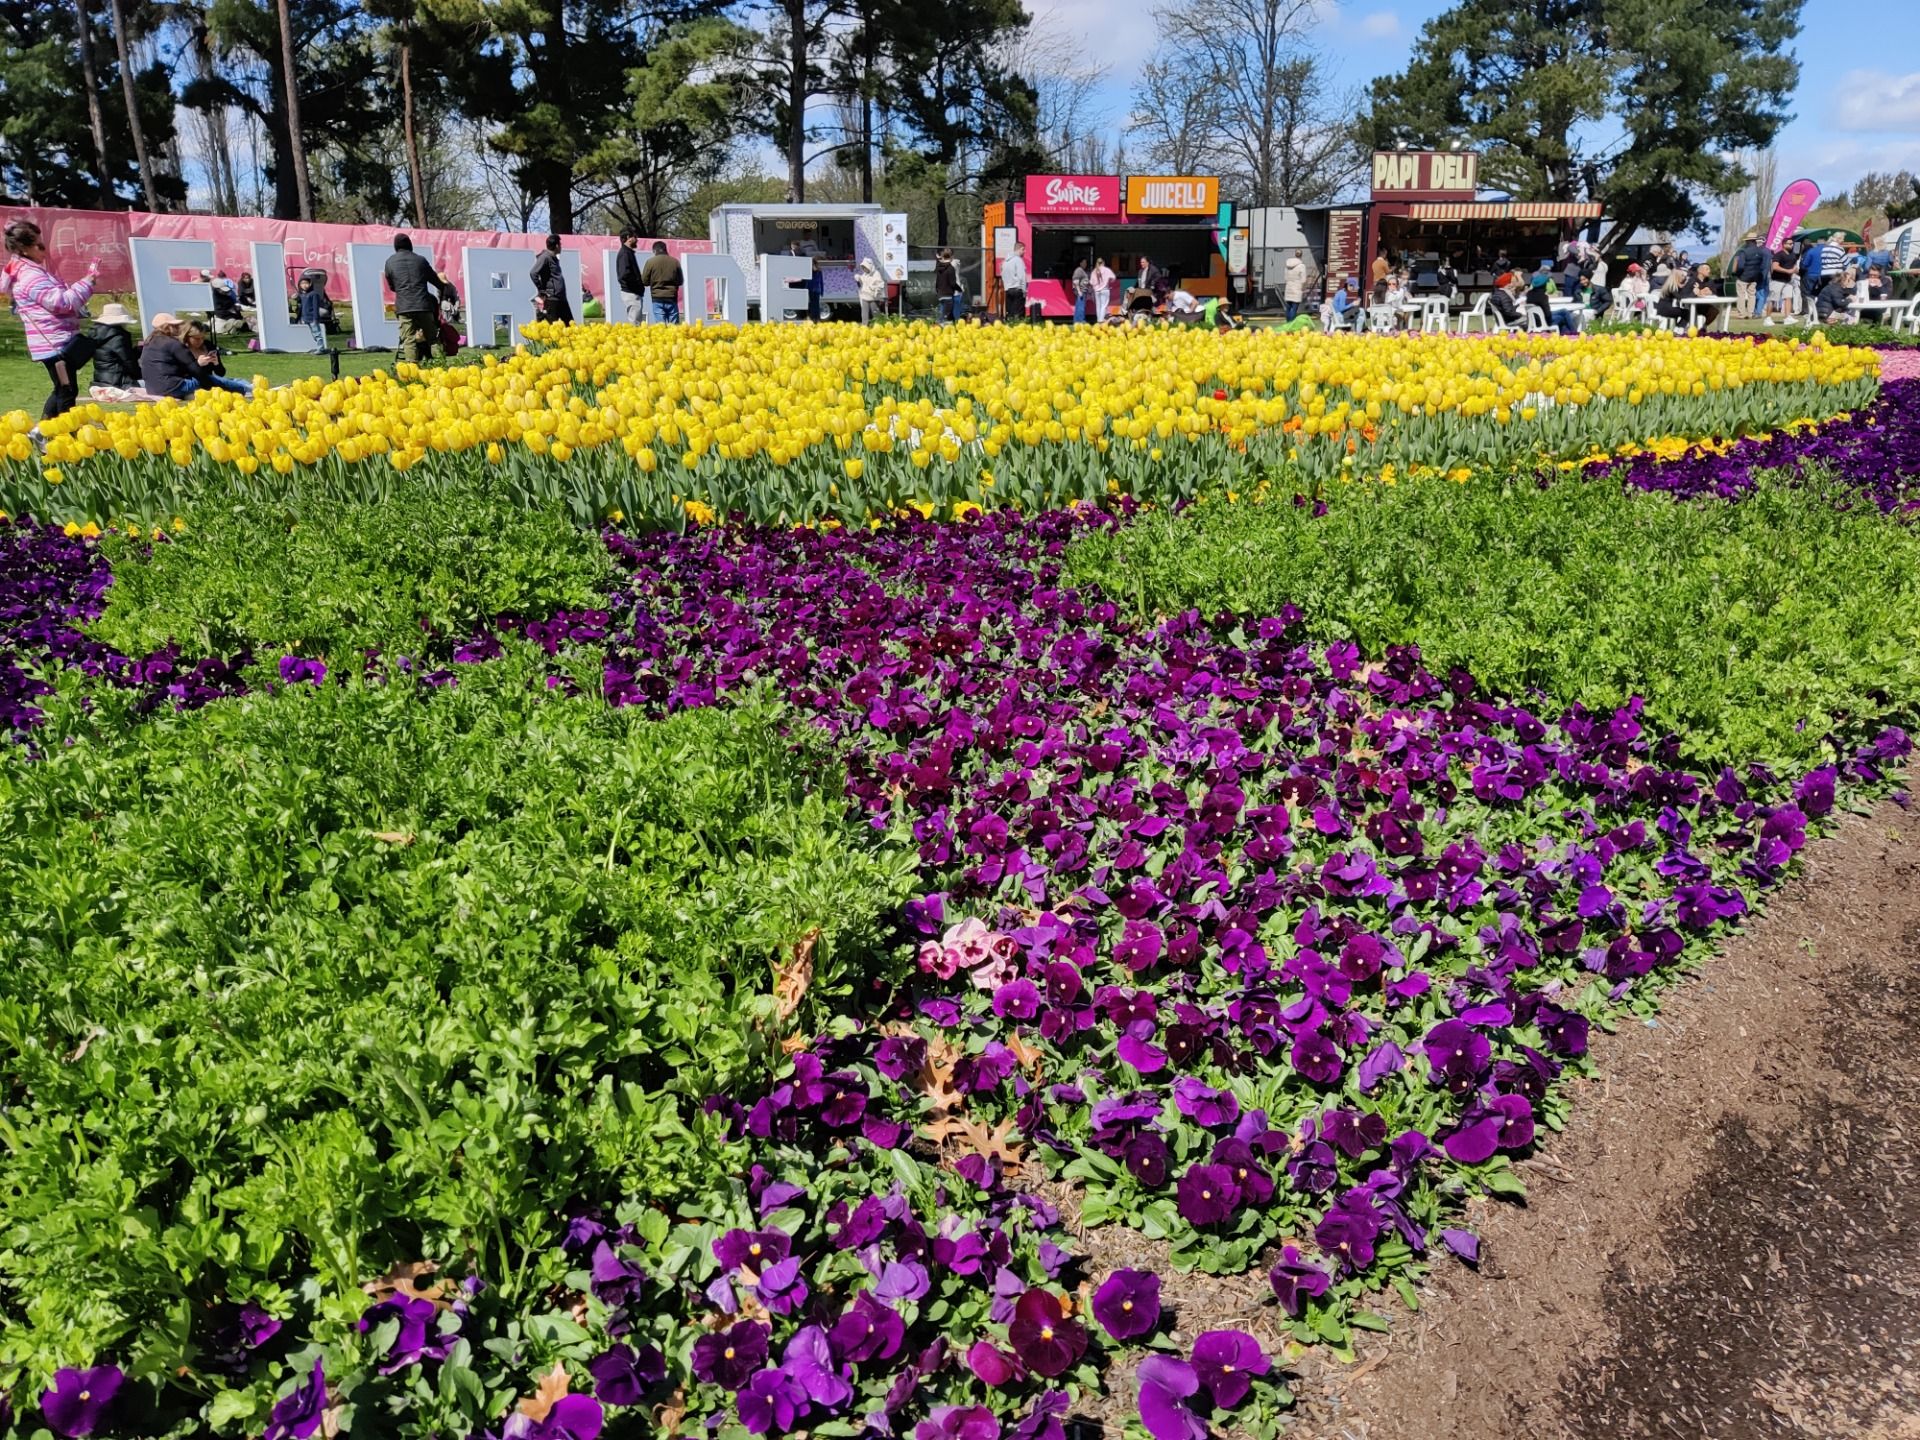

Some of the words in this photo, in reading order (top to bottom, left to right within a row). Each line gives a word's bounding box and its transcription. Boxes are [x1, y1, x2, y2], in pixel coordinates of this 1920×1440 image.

[1374, 154, 1419, 189] PAPI
[1430, 154, 1475, 189] DELI
[1140, 182, 1206, 209] JUICELLO
[1770, 215, 1792, 250] COFFEE
[284, 237, 348, 265] Floria
